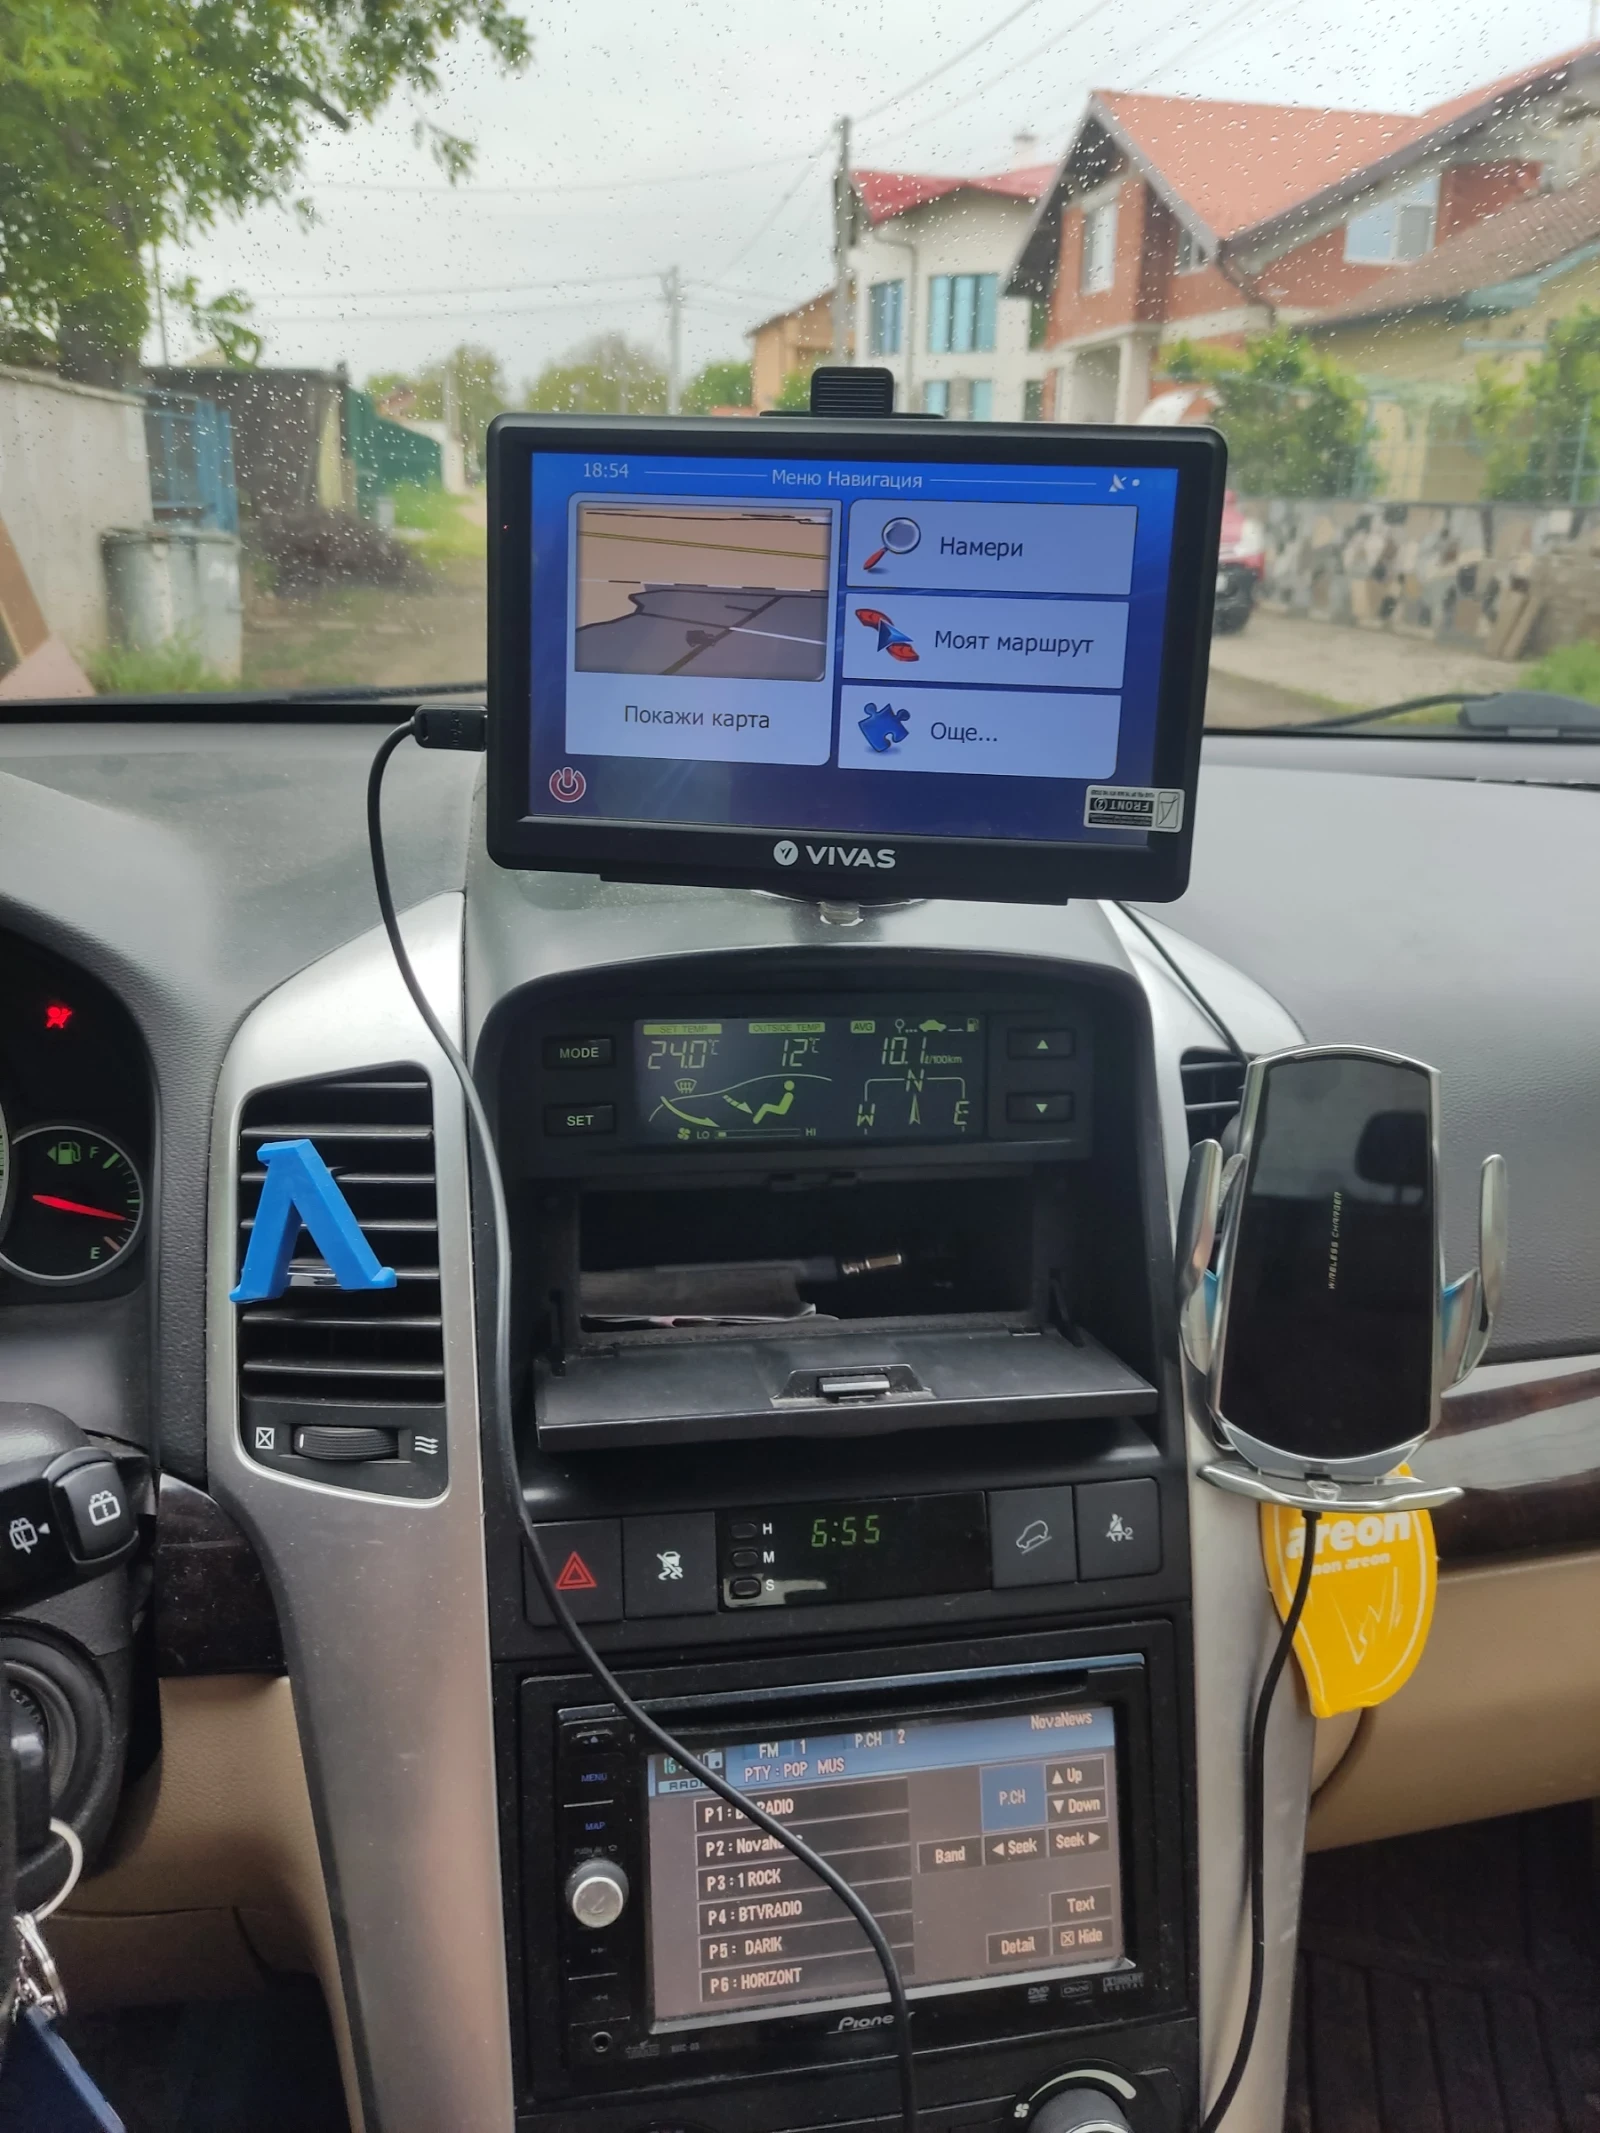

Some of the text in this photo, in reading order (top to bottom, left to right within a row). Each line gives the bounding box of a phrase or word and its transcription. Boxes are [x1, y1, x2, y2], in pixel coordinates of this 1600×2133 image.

[583, 463, 629, 478] 18:54
[772, 469, 923, 489] Меню Навигация
[940, 536, 1024, 561] Намери
[934, 630, 1094, 657] Моят маршрут
[624, 705, 770, 731] Покажи карта
[930, 721, 998, 743] Още...
[1110, 800, 1150, 812] FRONT
[805, 845, 896, 869] VIVAS
[659, 1024, 708, 1034] SET TEMP
[752, 1023, 821, 1033] OUTSIDE TEMP
[852, 1022, 873, 1031] AVG
[559, 1047, 599, 1059] MODE
[906, 1069, 925, 1092] N
[566, 1115, 594, 1126] SET
[857, 1103, 875, 1126] W
[953, 1101, 970, 1125] E
[697, 1130, 710, 1139] LO
[805, 1128, 817, 1137] HI
[89, 1146, 99, 1159] F
[1327, 1191, 1342, 1289] WIRELESS CHARGER
[90, 1246, 101, 1259] E
[762, 1522, 773, 1535] H
[811, 1515, 881, 1547] 6:55
[762, 1551, 775, 1563] M
[765, 1579, 775, 1591] S
[1031, 1711, 1092, 1730] NovaNews
[758, 1729, 906, 1759] FM 1 P.CH 2
[783, 1760, 808, 1778] POP
[817, 1757, 845, 1775] MUS
[1066, 1768, 1083, 1783] Up
[581, 1773, 607, 1782] MENU
[999, 1789, 1026, 1806] P.CH
[1068, 1798, 1101, 1814] Down
[585, 1821, 606, 1831] MAP
[1007, 1838, 1037, 1856] Seek
[1056, 1831, 1086, 1849] Seek
[935, 1845, 966, 1864] Band
[738, 1900, 802, 1922] BTVRADIO
[1067, 1895, 1096, 1913] Text
[1078, 1927, 1103, 1944] Hide
[744, 1936, 783, 1955] DARIK
[1001, 1936, 1036, 1955] Detail
[740, 1967, 802, 1990] HORIZONT
